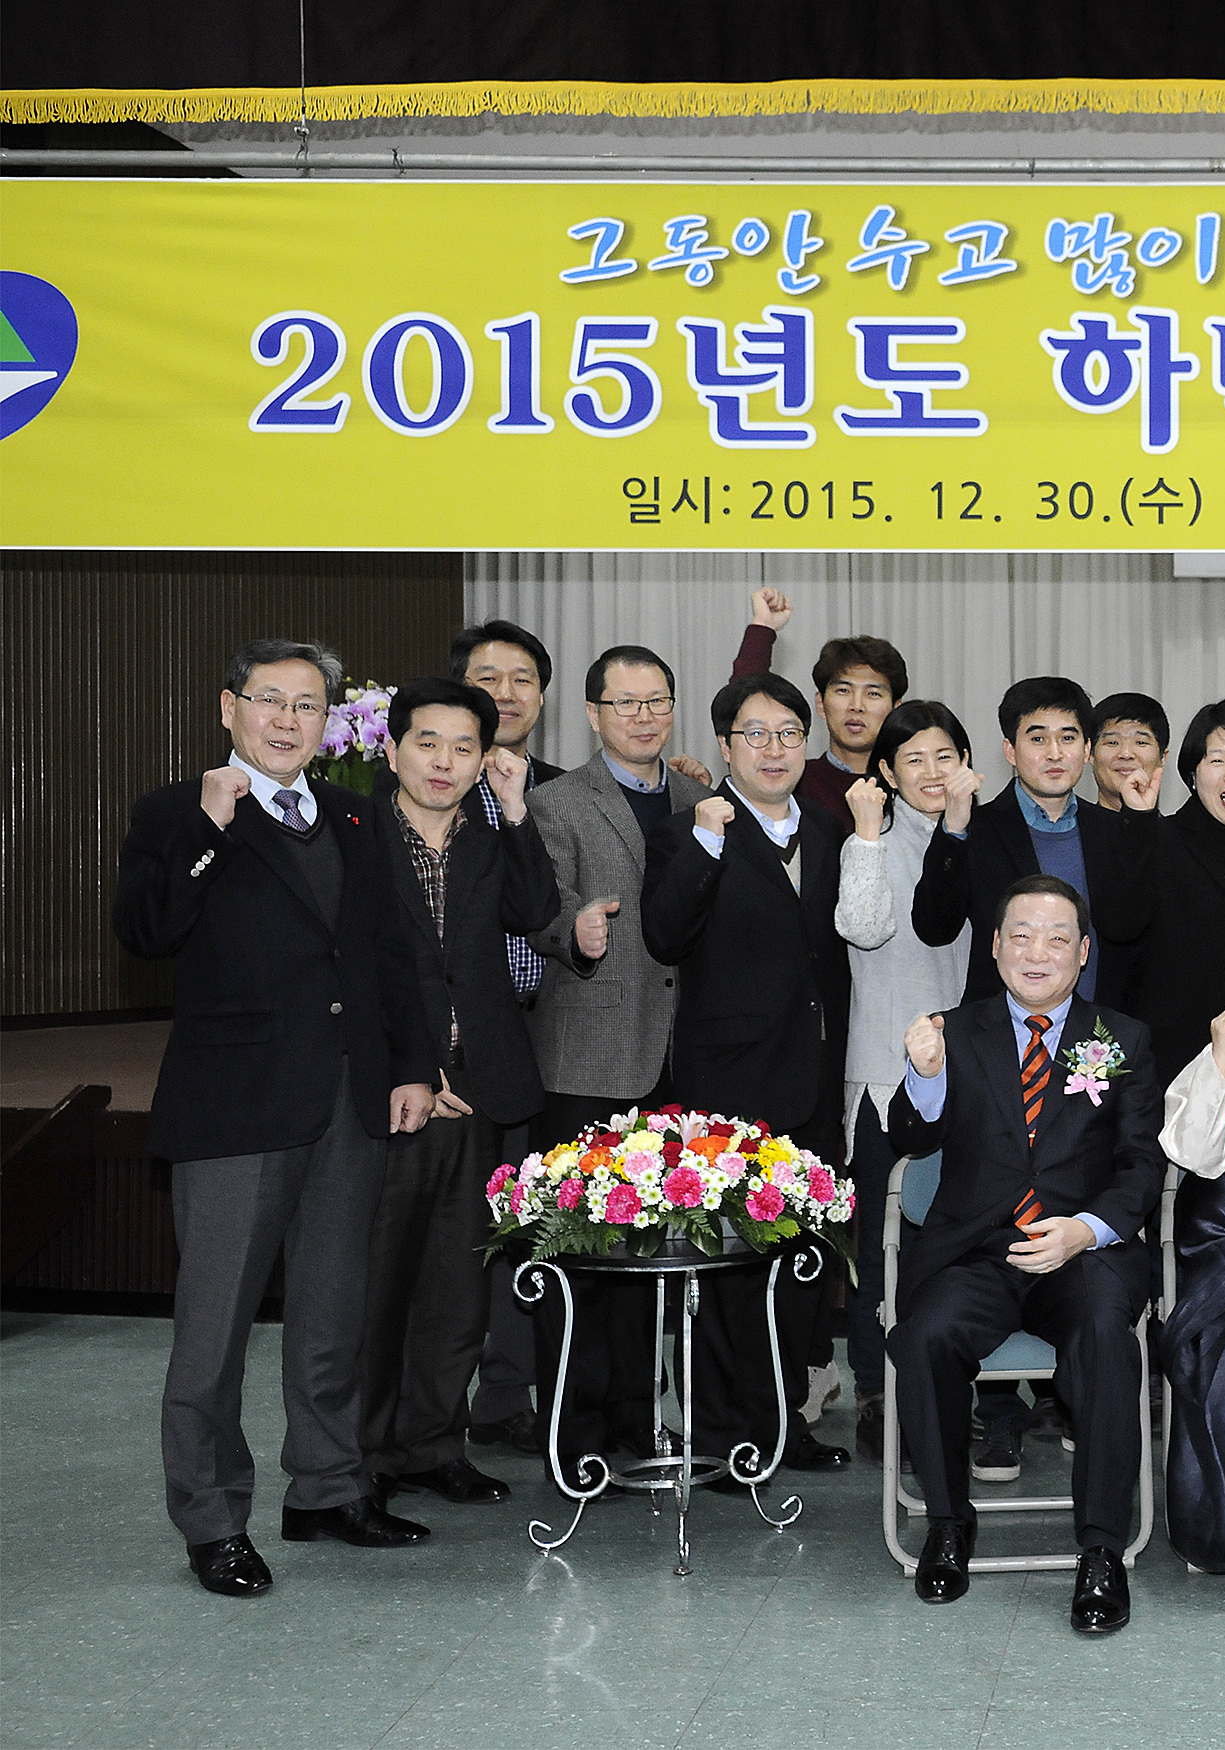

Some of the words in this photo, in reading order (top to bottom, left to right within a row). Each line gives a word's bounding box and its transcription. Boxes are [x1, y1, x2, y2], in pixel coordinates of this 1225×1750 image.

[560, 209, 824, 295] 그동안
[846, 204, 1017, 290] 수고
[1044, 212, 1221, 298] 많이
[250, 305, 988, 449] 2015년도
[621, 475, 732, 525] 일시:
[750, 480, 893, 523] 2015.
[930, 480, 1002, 523] 12.
[1036, 477, 1203, 527] 30.(수)
